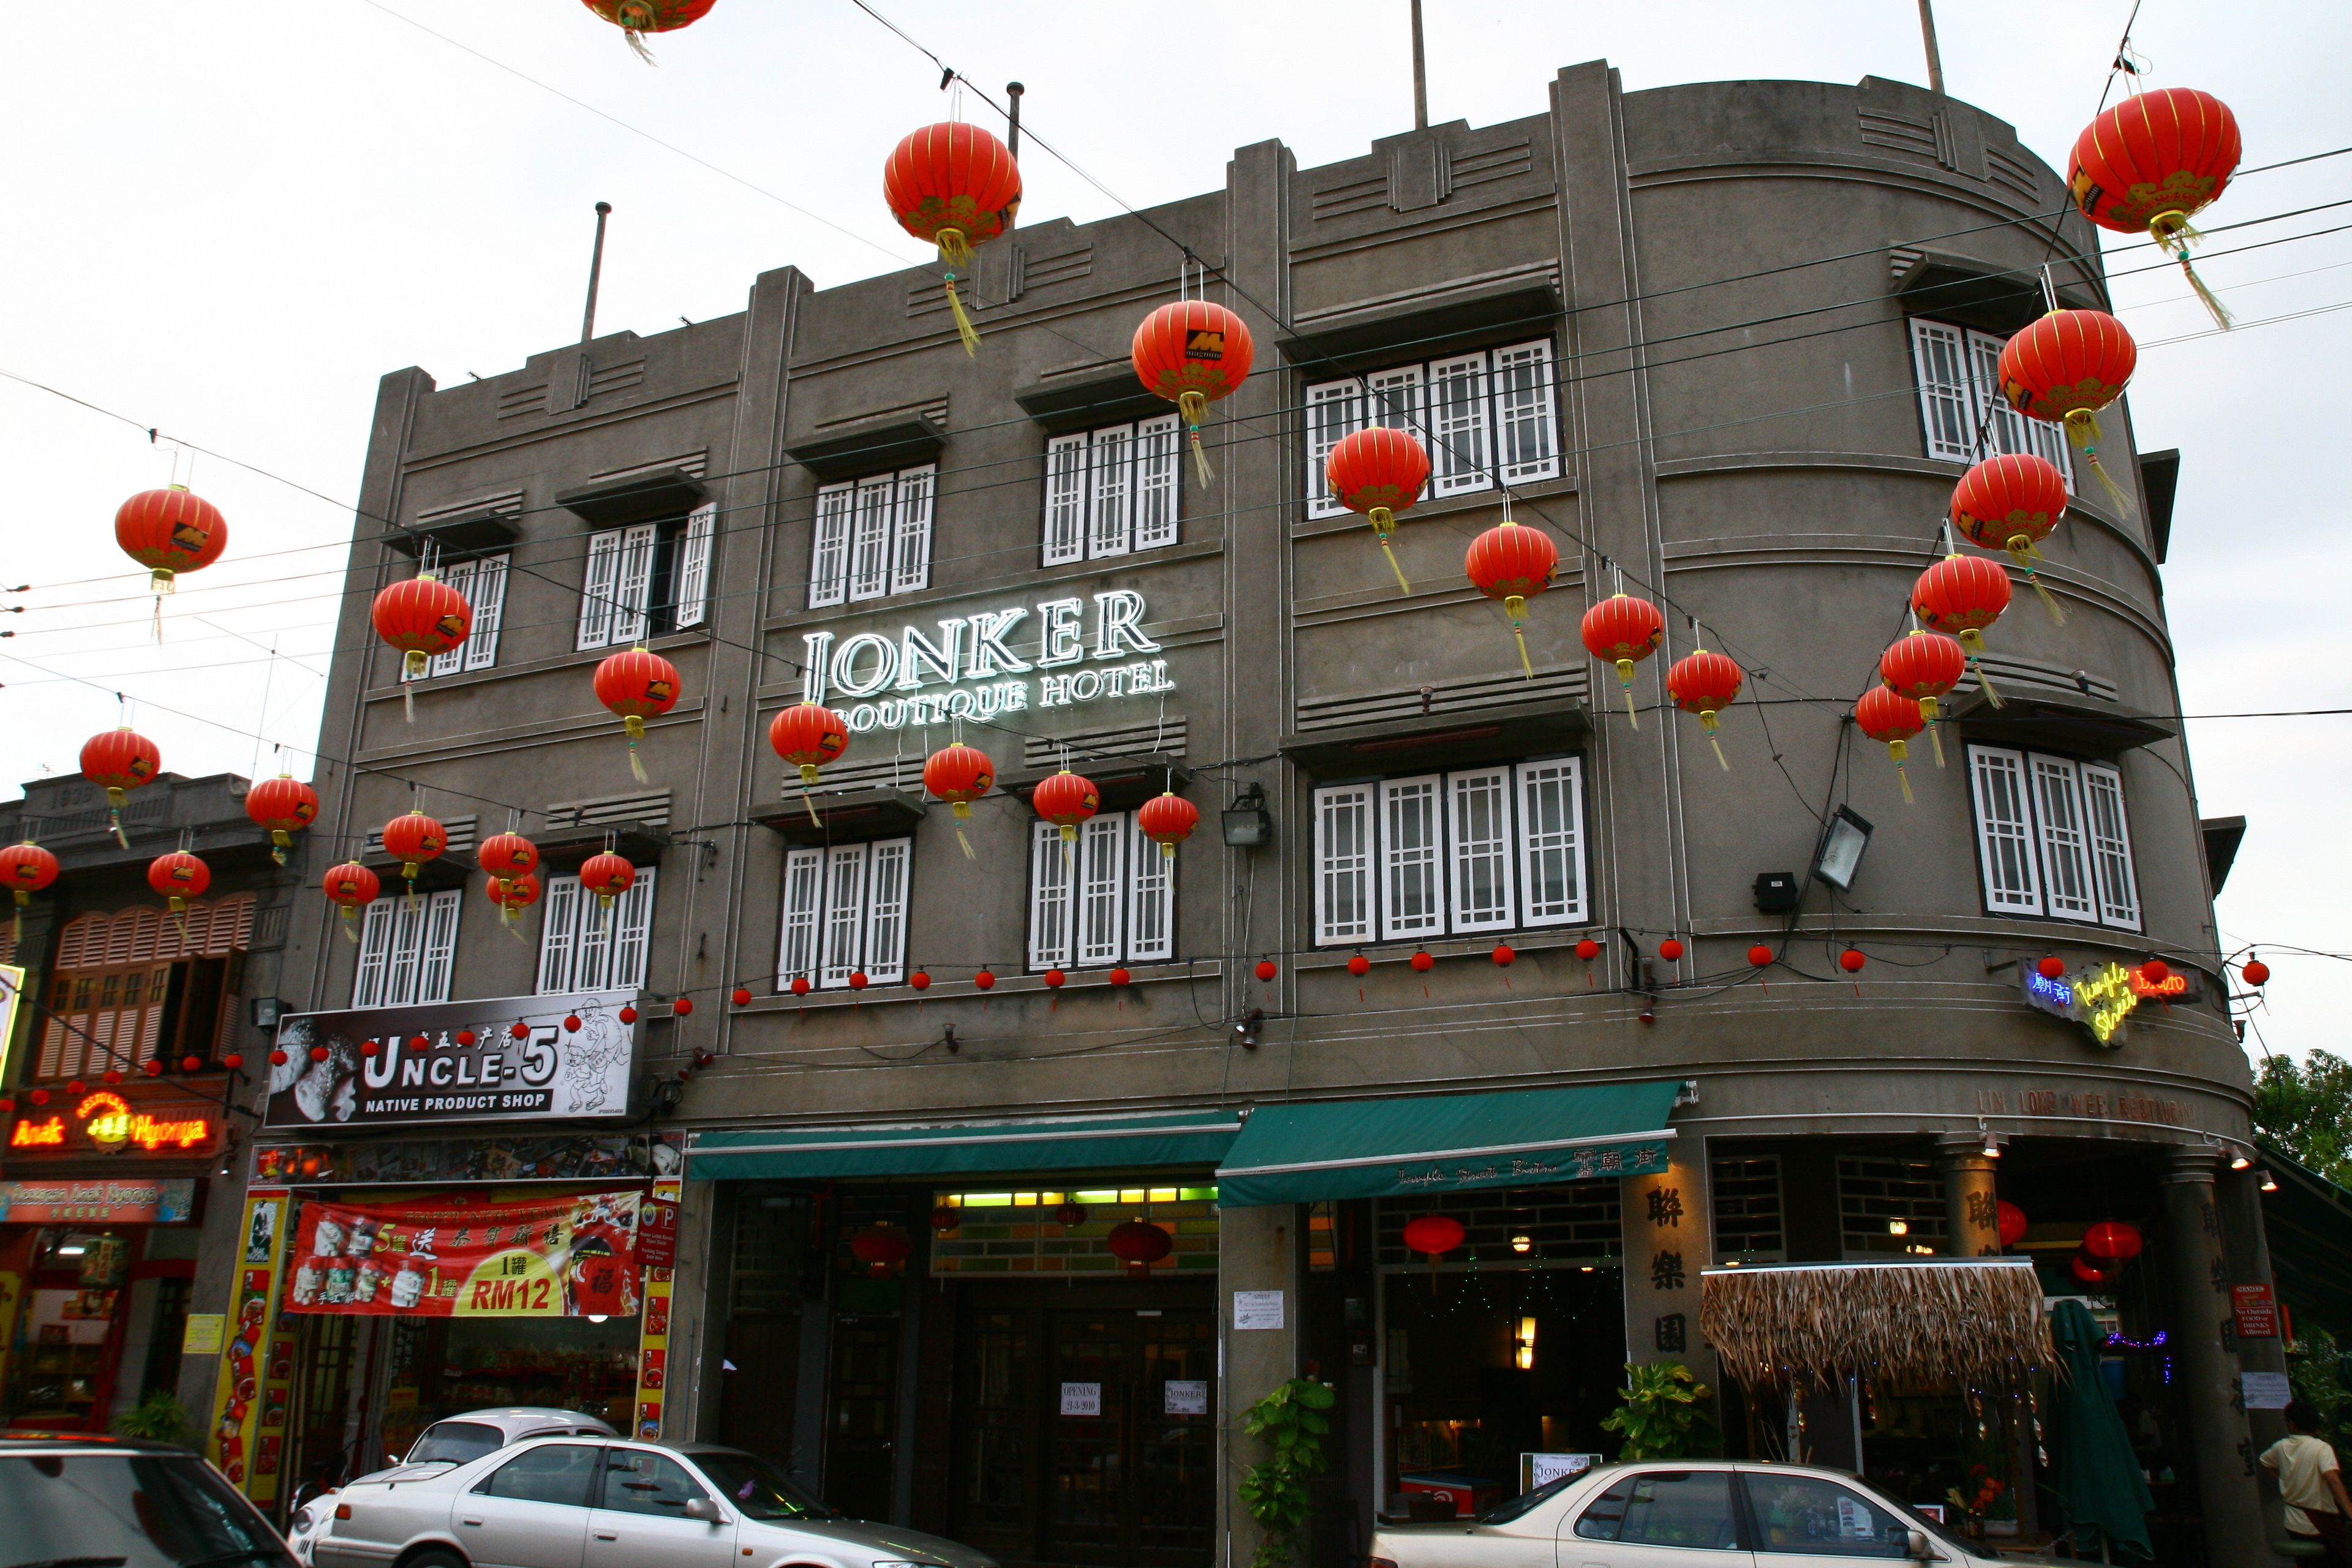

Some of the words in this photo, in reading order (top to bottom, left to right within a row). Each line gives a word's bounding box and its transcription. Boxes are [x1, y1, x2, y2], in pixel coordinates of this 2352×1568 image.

[803, 589, 1162, 706] JONKER
[1040, 660, 1174, 707] HOTEL
[2032, 972, 2071, 1005] 廟街
[2073, 961, 2130, 1006] Temple
[419, 1025, 513, 1051] 五产店
[364, 1025, 559, 1088] UNCLE-5
[366, 1098, 419, 1112] NATIVE
[424, 1096, 497, 1110] PRODUCT
[502, 1093, 546, 1107] SHOP
[12, 1116, 65, 1146] Anak
[133, 1114, 207, 1149] Nyonya
[1598, 1147, 1657, 1172] 廟街
[1398, 1167, 1446, 1186] Temple
[1456, 1166, 1498, 1185] Street
[664, 1207, 674, 1226] P
[470, 1278, 551, 1310] RM12
[1064, 1386, 1096, 1396] OPENING
[1066, 1401, 1095, 1411] 21-3-2010
